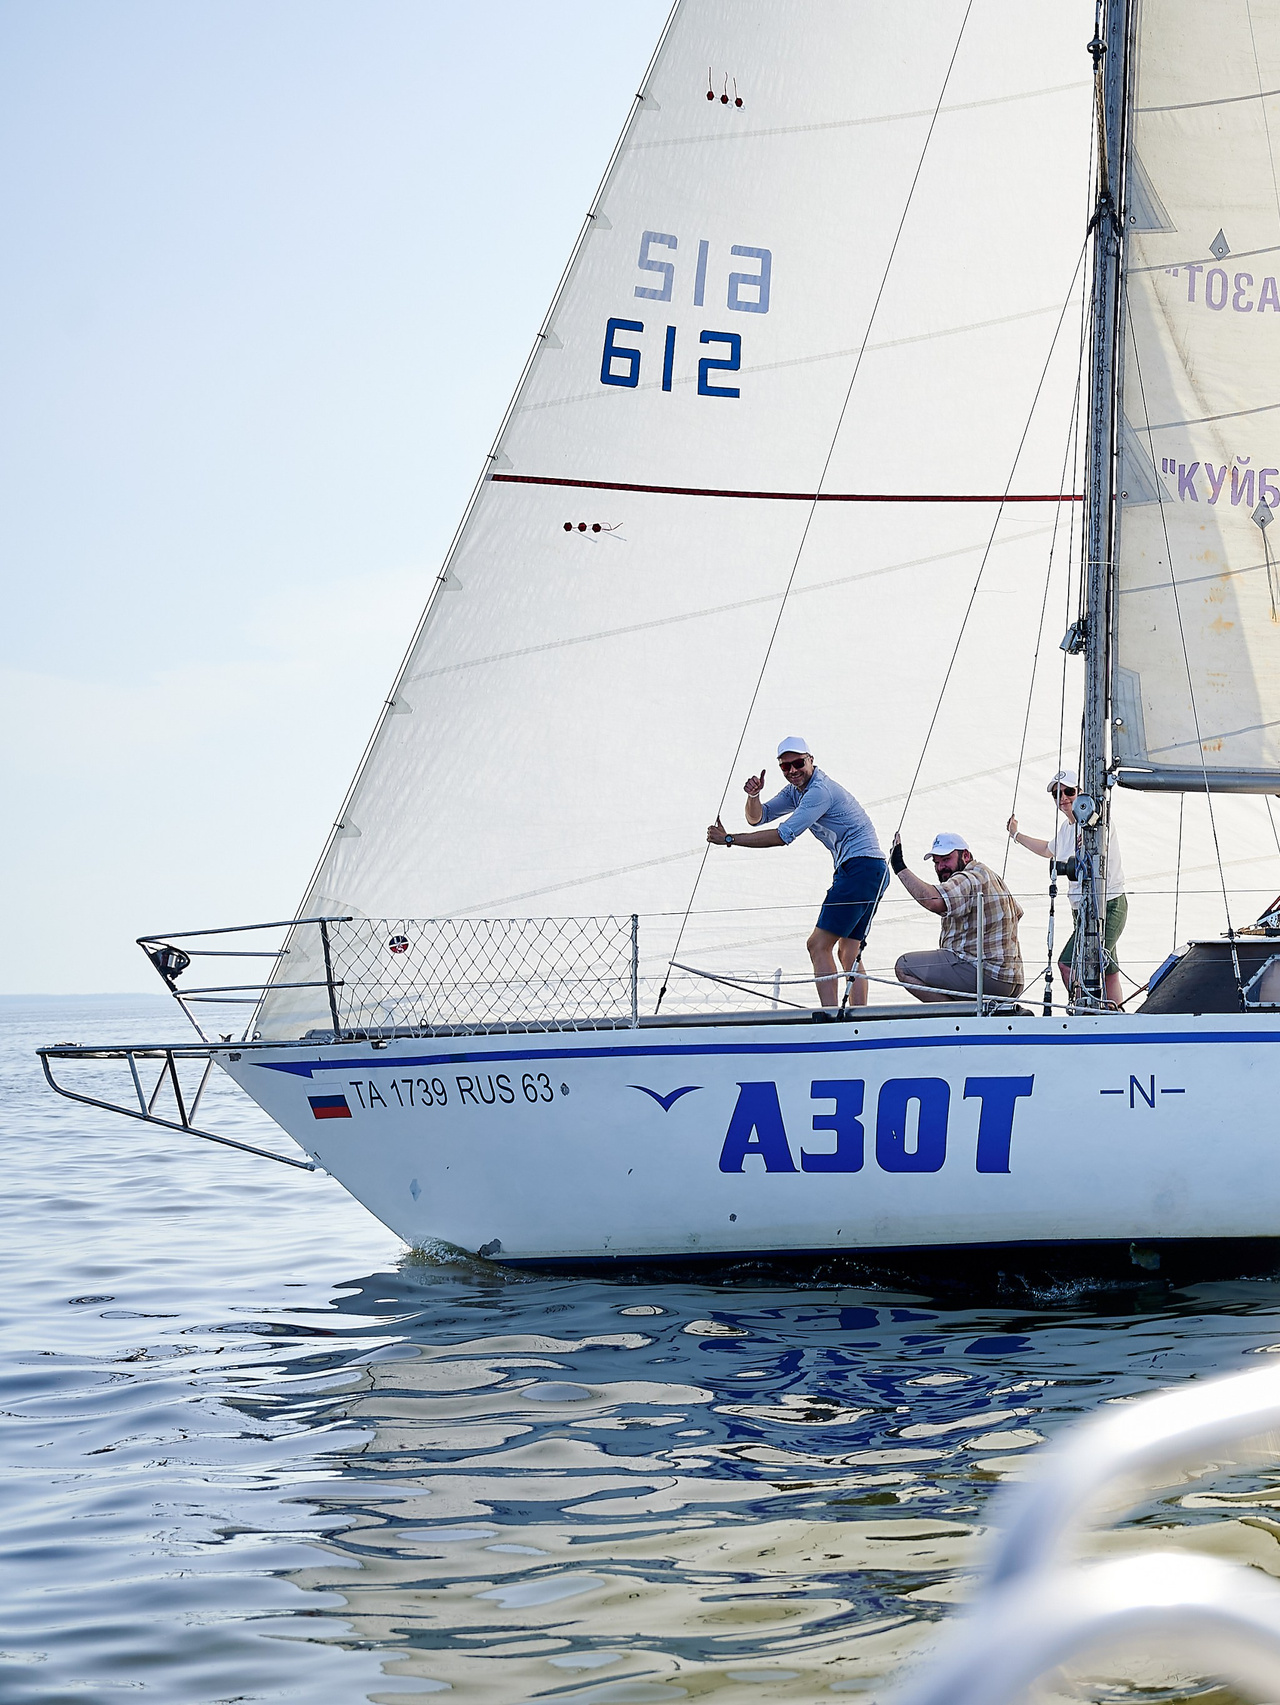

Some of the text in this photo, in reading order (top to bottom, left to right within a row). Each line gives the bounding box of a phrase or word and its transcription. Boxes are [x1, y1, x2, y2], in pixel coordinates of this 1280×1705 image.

[600, 316, 742, 399] 612
[349, 1071, 555, 1109] TA 1739 RUS 63
[718, 1073, 1036, 1174] АЗОТ
